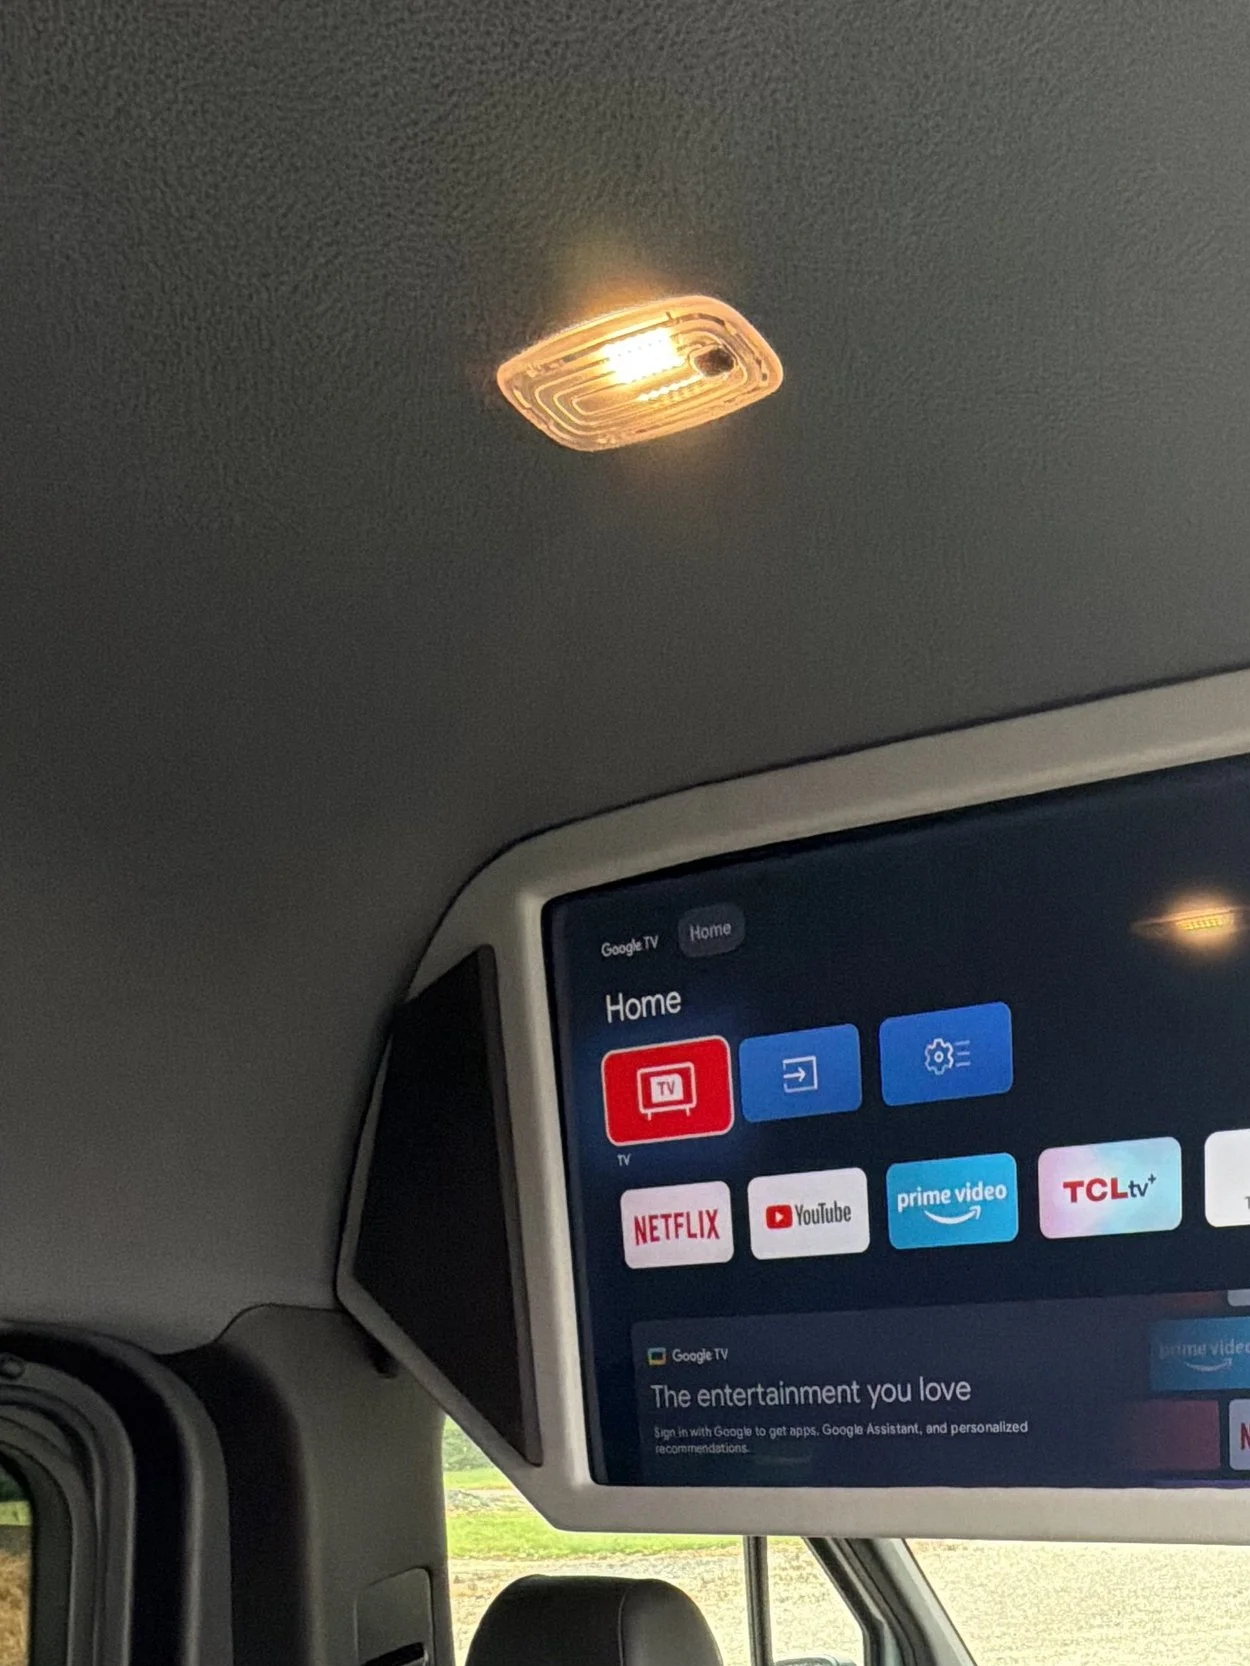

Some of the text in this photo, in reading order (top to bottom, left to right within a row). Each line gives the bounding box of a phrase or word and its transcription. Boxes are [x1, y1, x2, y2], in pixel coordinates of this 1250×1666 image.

[689, 923, 732, 941] Home
[601, 935, 660, 957] Google TV
[606, 991, 682, 1024] Home
[656, 1081, 676, 1097] TV
[616, 1153, 632, 1167] TV
[897, 1180, 1008, 1213] prime video
[794, 1200, 852, 1226] YouTube
[633, 1208, 721, 1246] NETFLIX
[671, 1348, 729, 1365] Google TV
[1158, 1340, 1206, 1359] prime
[650, 1376, 972, 1410] The entertainment you love
[653, 1426, 676, 1442] Sign
[677, 1426, 689, 1438] in
[689, 1426, 712, 1438] with
[713, 1425, 752, 1440] Google
[755, 1427, 766, 1437] to
[768, 1426, 787, 1440] get
[821, 1423, 864, 1439] Google
[866, 1422, 924, 1437] Assistant,
[925, 1421, 949, 1435] and
[950, 1420, 1029, 1437] personalized
